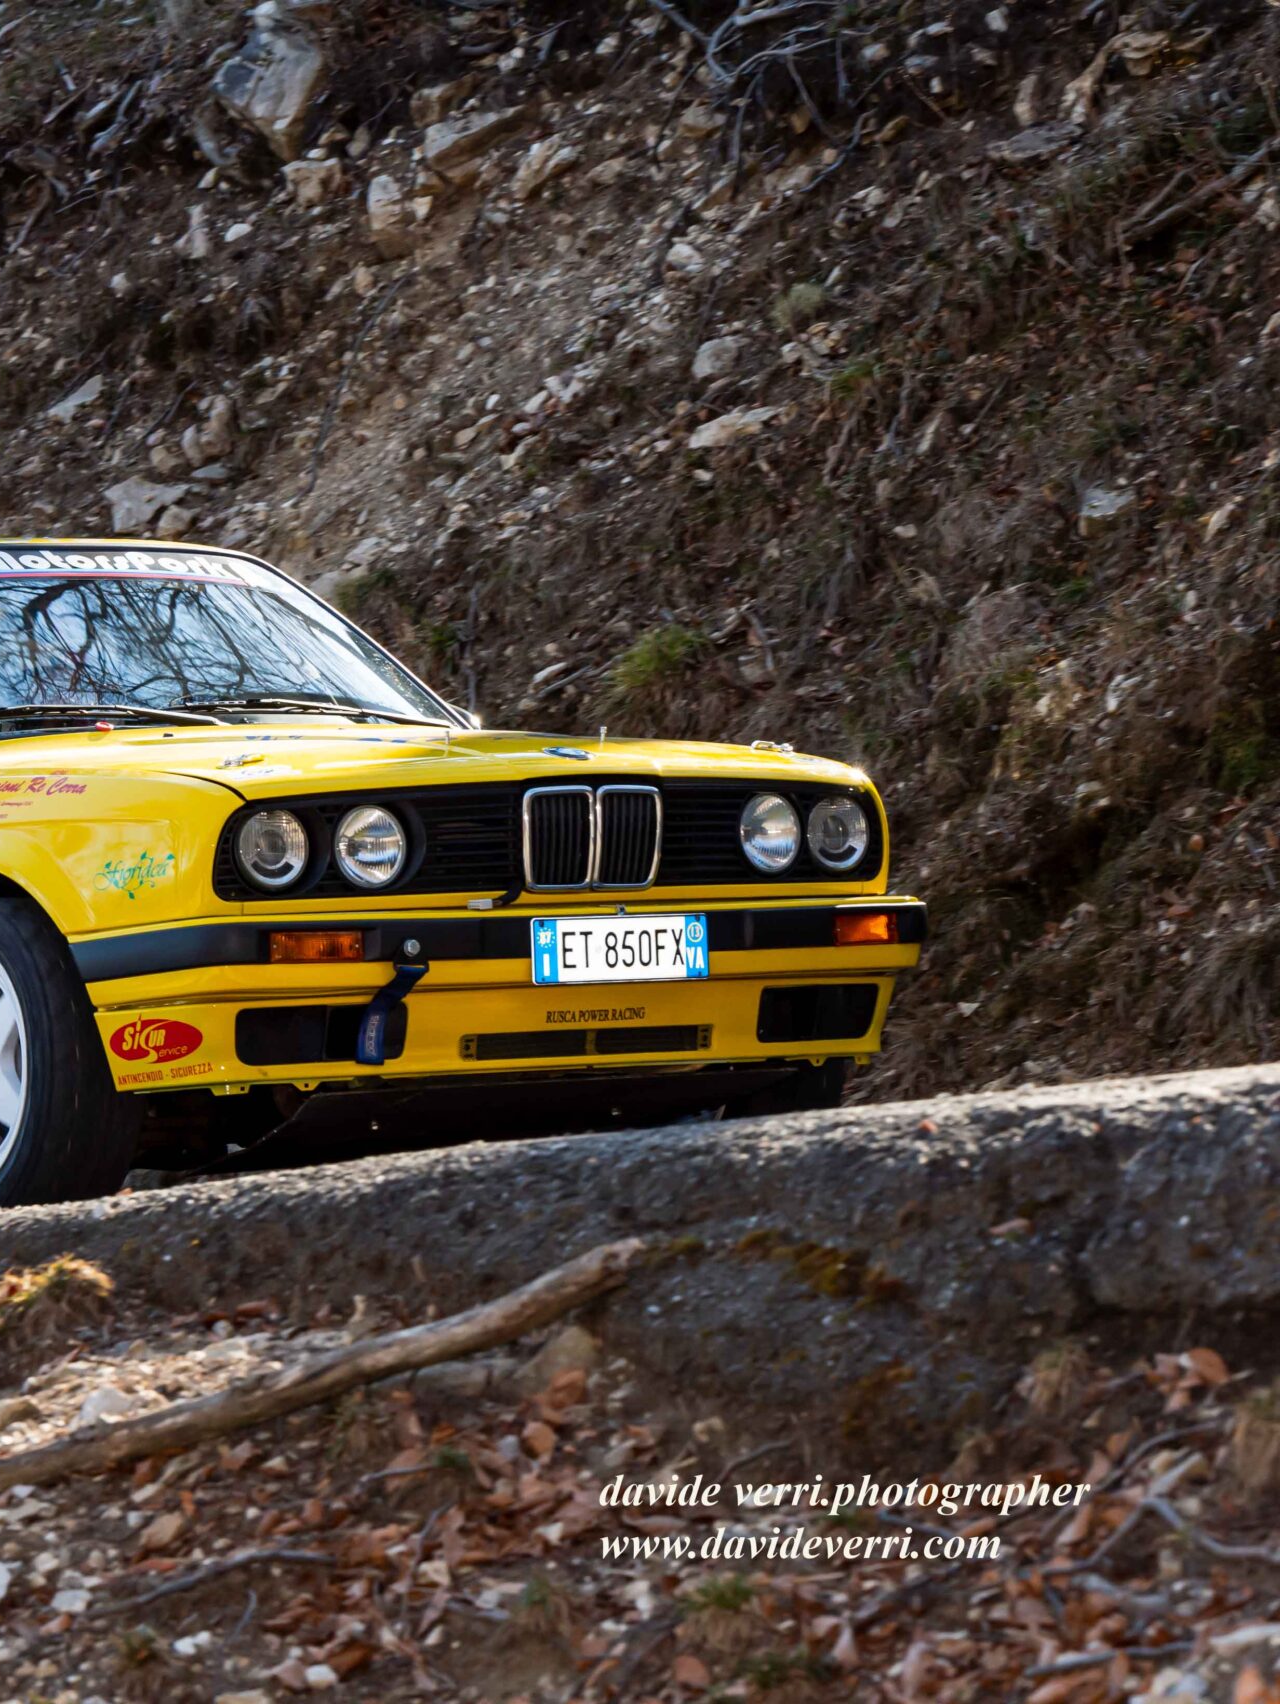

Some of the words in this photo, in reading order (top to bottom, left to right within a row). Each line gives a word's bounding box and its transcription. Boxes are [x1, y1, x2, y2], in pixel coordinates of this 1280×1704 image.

[562, 931, 593, 969] ET
[604, 929, 685, 969] 850FX
[686, 947, 705, 969] VA
[546, 1010, 576, 1024] RUSCA
[578, 1009, 609, 1022] POWER
[610, 1007, 646, 1020] RACING
[118, 1069, 164, 1086] ANTINCENDIO
[170, 1062, 214, 1079] SICUREZZA
